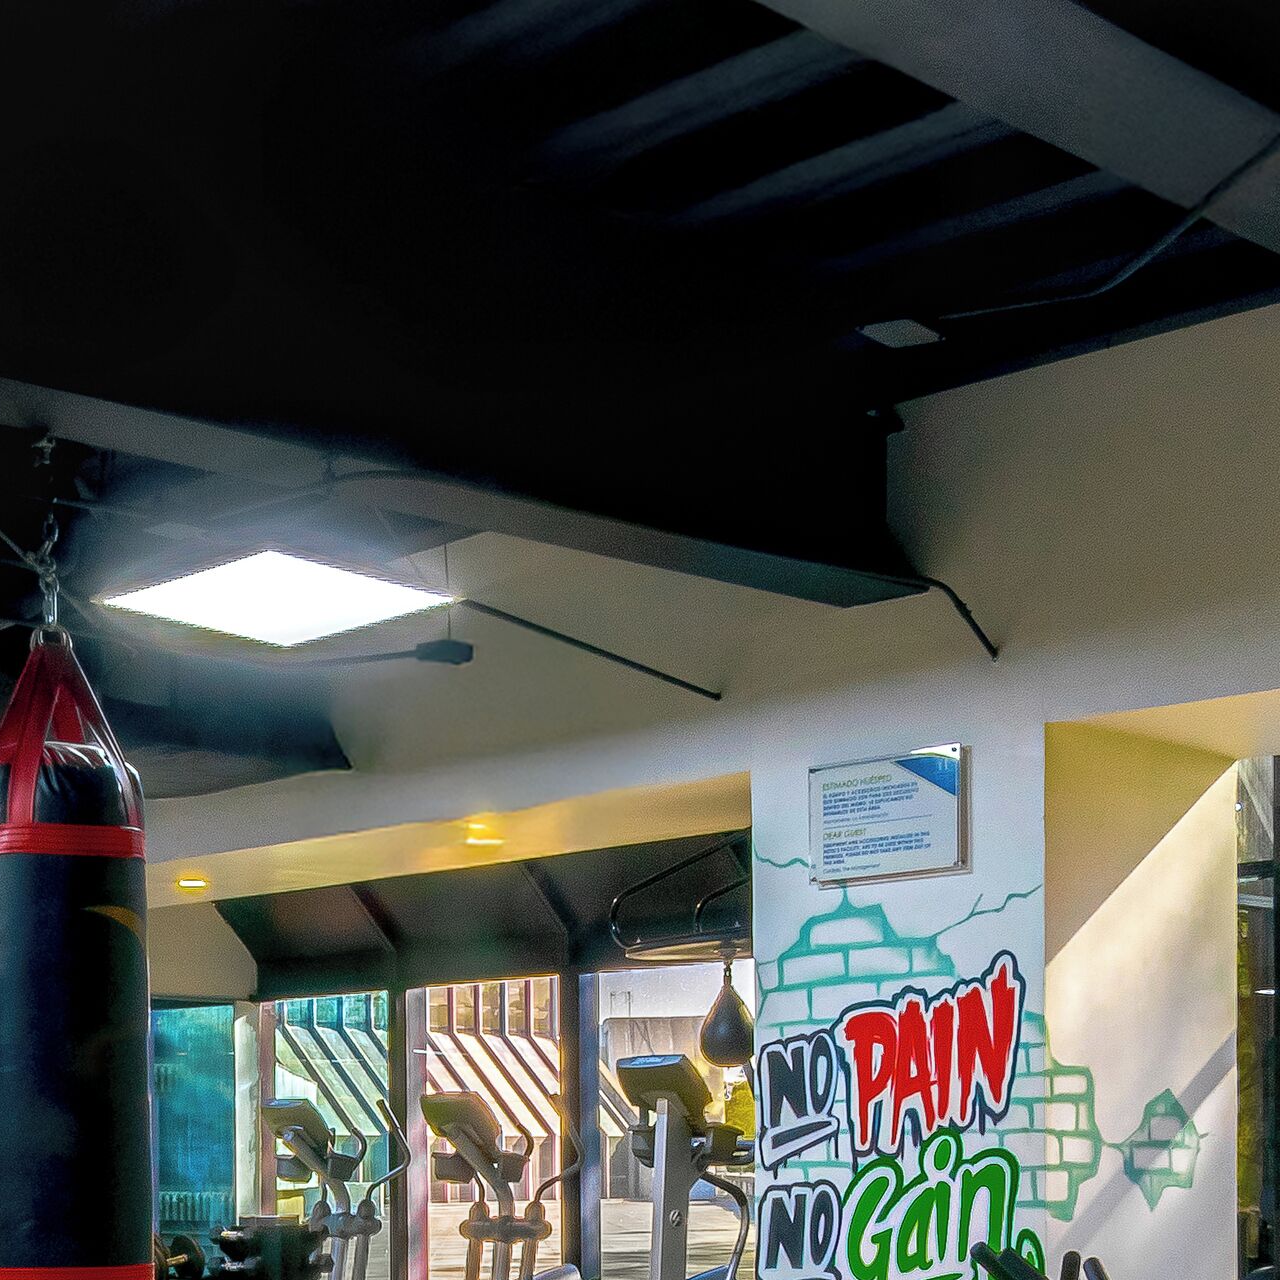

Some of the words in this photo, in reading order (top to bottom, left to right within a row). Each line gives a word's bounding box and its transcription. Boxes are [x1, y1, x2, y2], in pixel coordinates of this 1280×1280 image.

[758, 1031, 840, 1135] NO
[838, 952, 1024, 1155] PAIN
[756, 1181, 840, 1275] NO
